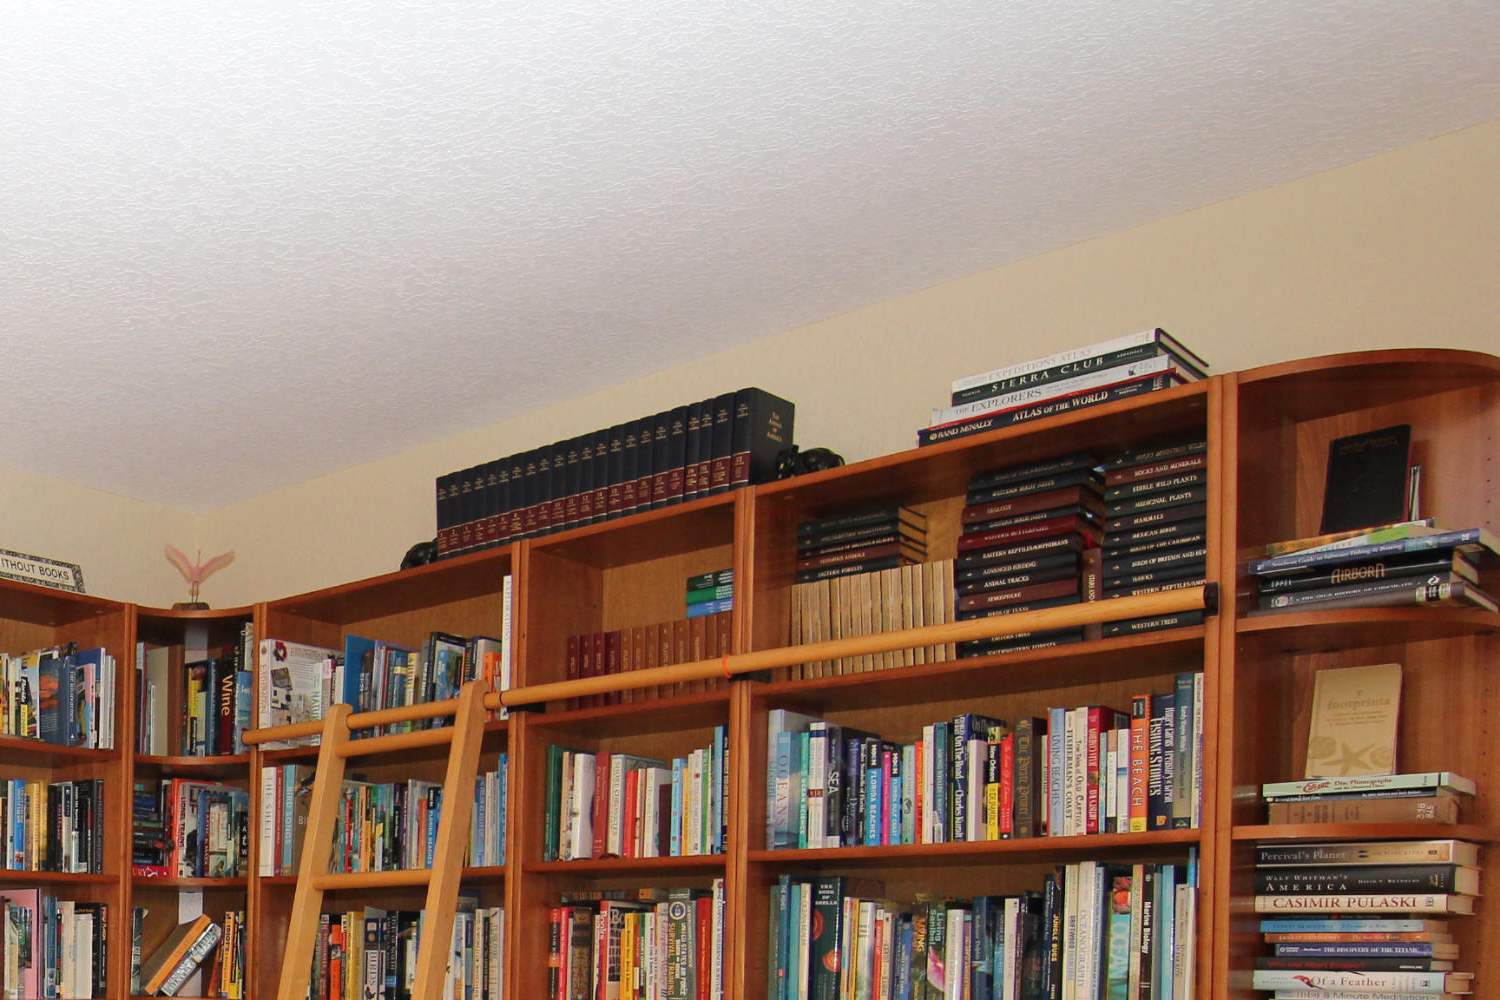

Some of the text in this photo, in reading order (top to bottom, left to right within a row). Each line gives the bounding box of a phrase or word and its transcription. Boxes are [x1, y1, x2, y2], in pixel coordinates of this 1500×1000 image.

[991, 370, 1049, 392] SIERRA
[1060, 356, 1104, 375] CLUB
[1013, 391, 1108, 422] ATLAS OF THE WORLD
[39, 566, 69, 580] BOOKS
[222, 674, 233, 717] Wine
[954, 735, 962, 745] On
[954, 746, 964, 760] The
[954, 761, 964, 779] Road
[989, 745, 997, 782] New Orleans
[1051, 734, 1061, 806] LIVING BEACHES
[1131, 727, 1143, 807] THE BEACH
[1149, 756, 1162, 796] STORIES
[777, 755, 789, 825] OCEANS
[827, 771, 839, 795] SEA
[869, 770, 878, 802] FLORIDA
[264, 776, 273, 841] THE SHELL
[284, 786, 294, 845] BIRD SONGS
[869, 804, 877, 839] BEACHES
[1065, 792, 1073, 820] COAST
[1261, 848, 1346, 862] Percival's Planet
[1266, 882, 1347, 892] AMERICA
[1273, 896, 1417, 909] CASIMIR PULASKI
[668, 923, 676, 958] SURVIVAL
[1052, 914, 1060, 941] JUNGLE
[1141, 901, 1151, 954] Marine Biology
[1111, 922, 1126, 980] OCEAN
[369, 951, 378, 986] BIRDS
[1311, 976, 1327, 986] Of
[1341, 976, 1387, 987] Feather
[1379, 993, 1430, 1000] Meditation
